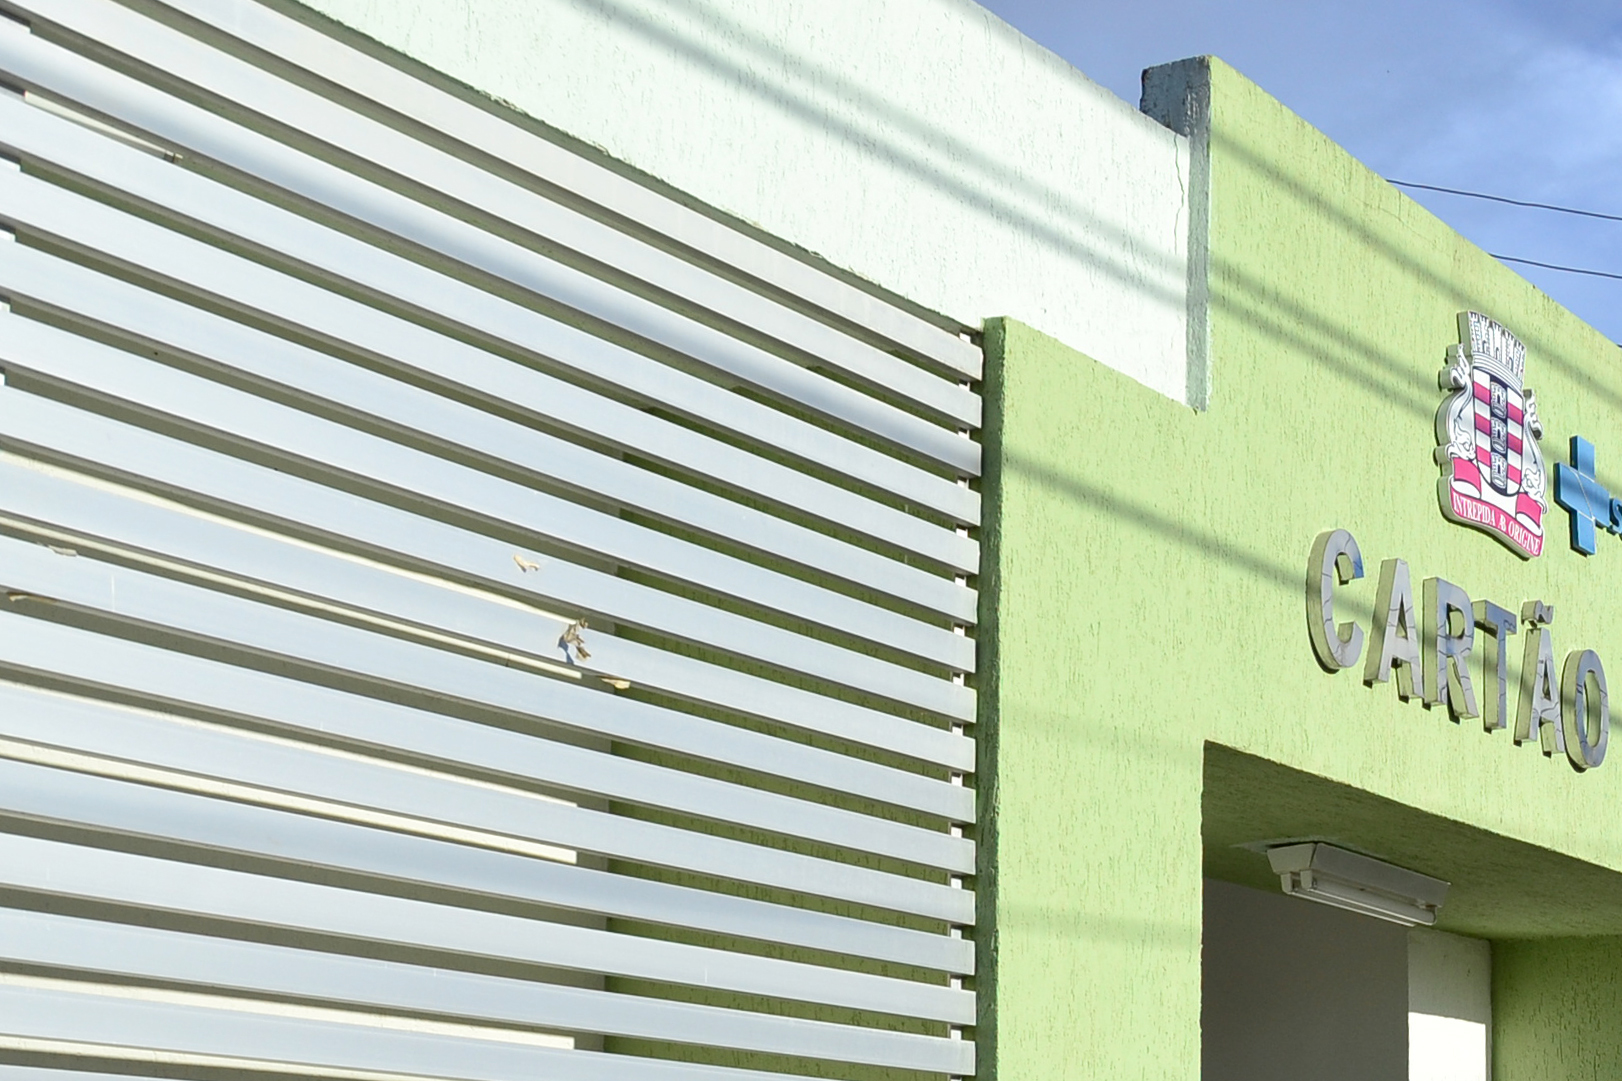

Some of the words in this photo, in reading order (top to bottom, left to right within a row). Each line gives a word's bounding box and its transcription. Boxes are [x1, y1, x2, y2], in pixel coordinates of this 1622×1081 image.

[1453, 492, 1496, 526] INTREPIDA
[1508, 520, 1541, 556] ORIGINE
[1306, 528, 1610, 773] CARTÃO
